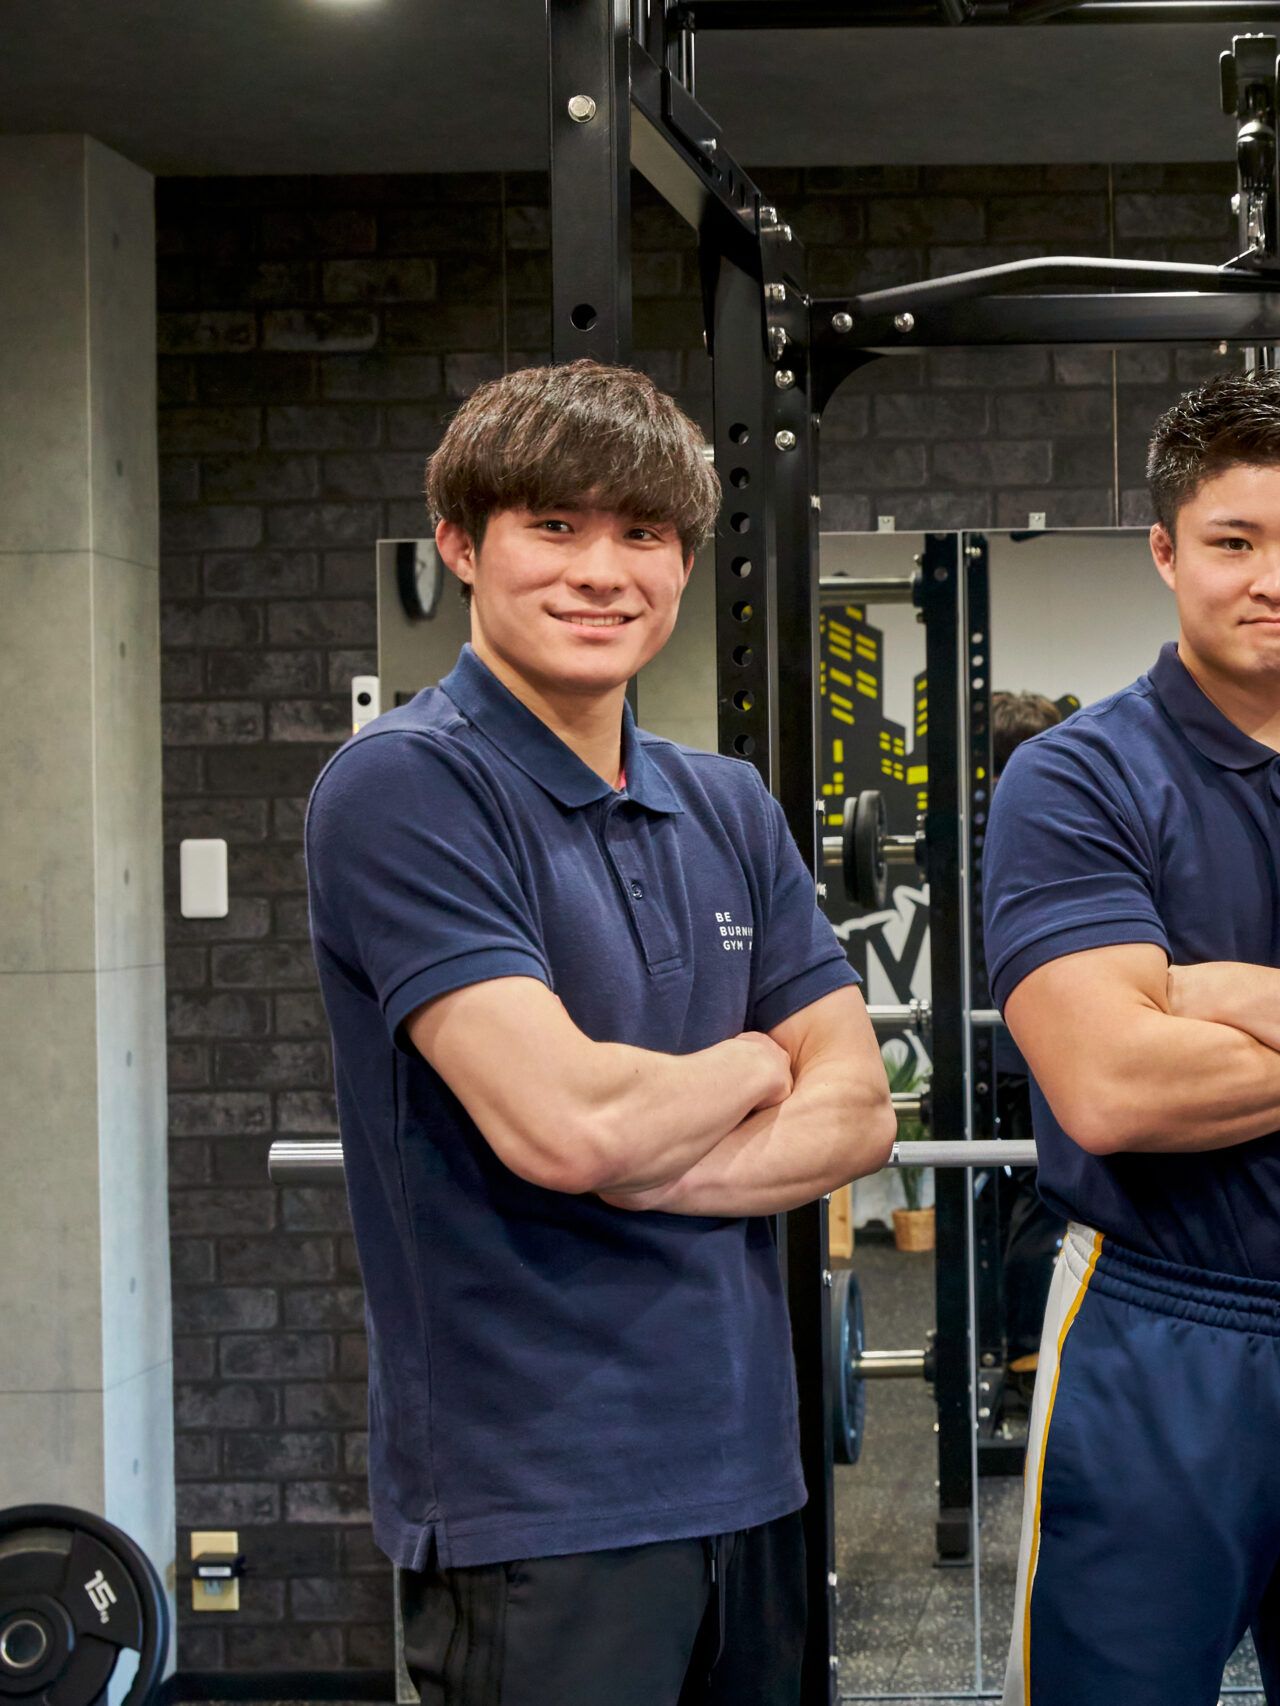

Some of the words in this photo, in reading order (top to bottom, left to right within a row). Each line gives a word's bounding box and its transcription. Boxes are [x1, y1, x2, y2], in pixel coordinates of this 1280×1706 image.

[715, 911, 732, 923] BE
[723, 940, 743, 951] GYM
[84, 1569, 117, 1611] 15
